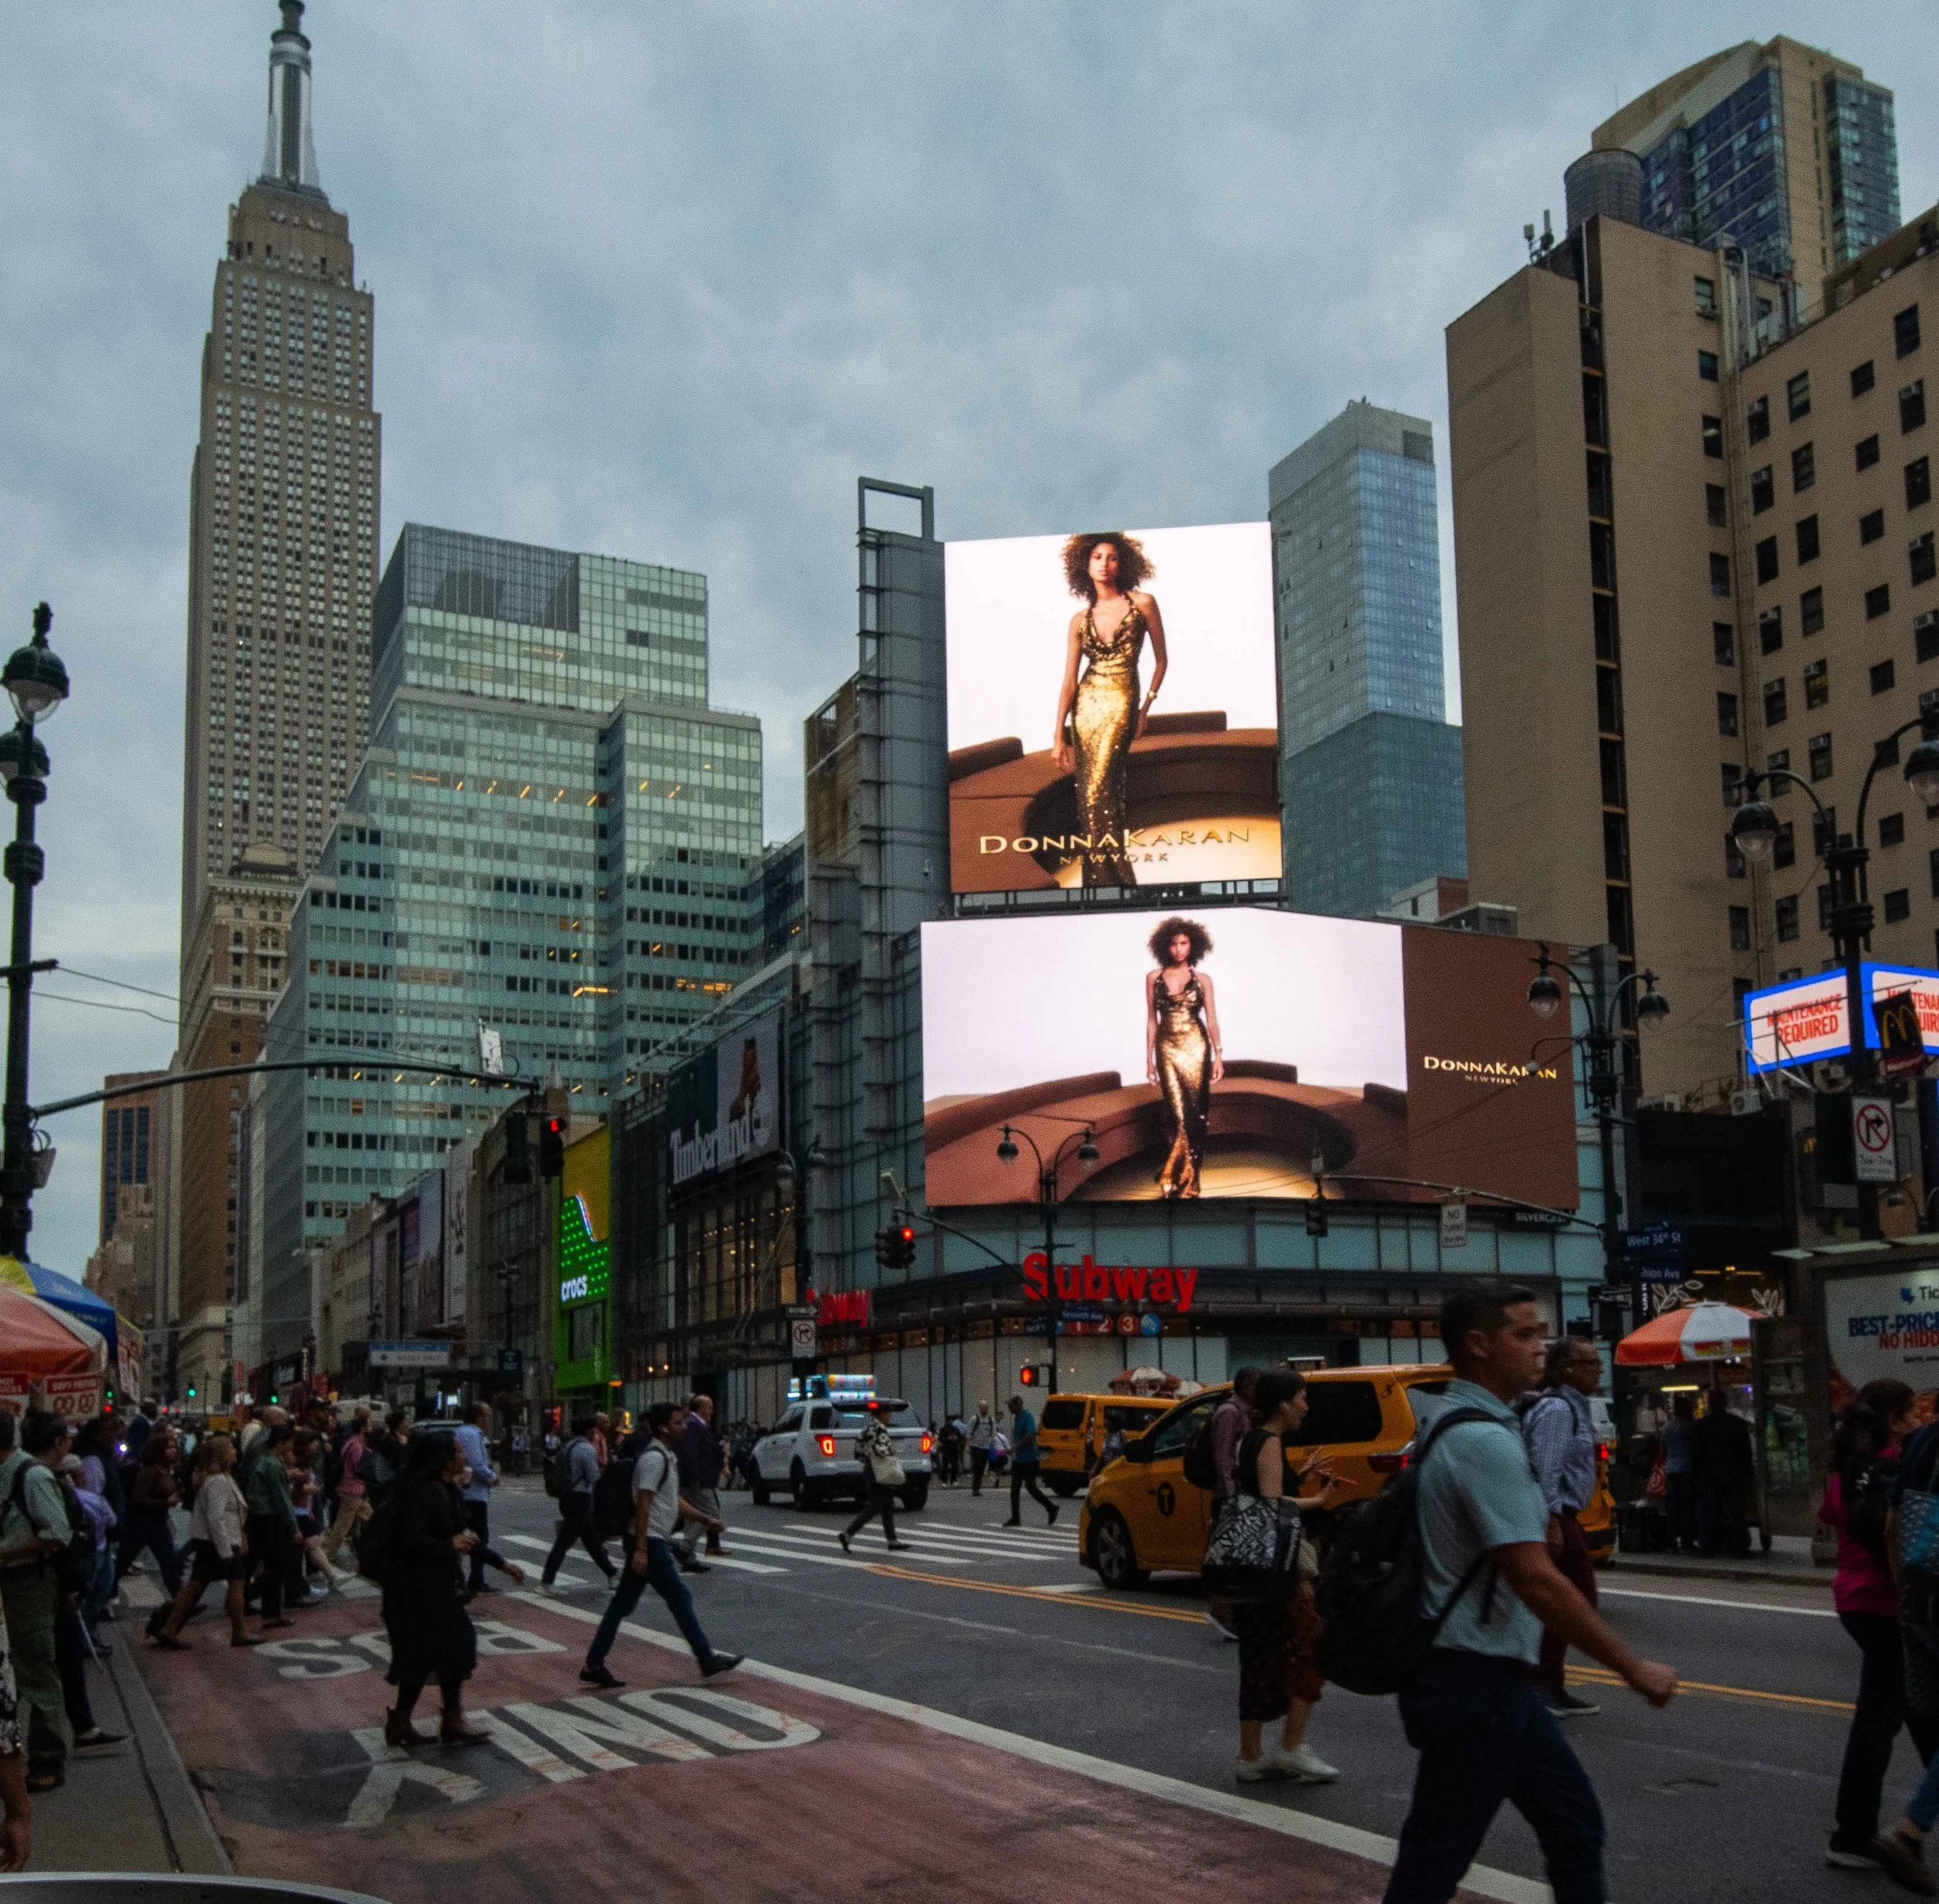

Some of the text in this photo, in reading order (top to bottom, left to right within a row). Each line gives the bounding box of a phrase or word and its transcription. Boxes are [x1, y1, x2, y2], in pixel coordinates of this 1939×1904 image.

[1778, 1014, 1838, 1045] REQUIRED
[1627, 1235, 1650, 1248] West
[561, 1275, 588, 1302] crocs
[1023, 1253, 1198, 1312] Subway
[1123, 1316, 1134, 1333] 3
[1879, 1333, 1900, 1350] NO
